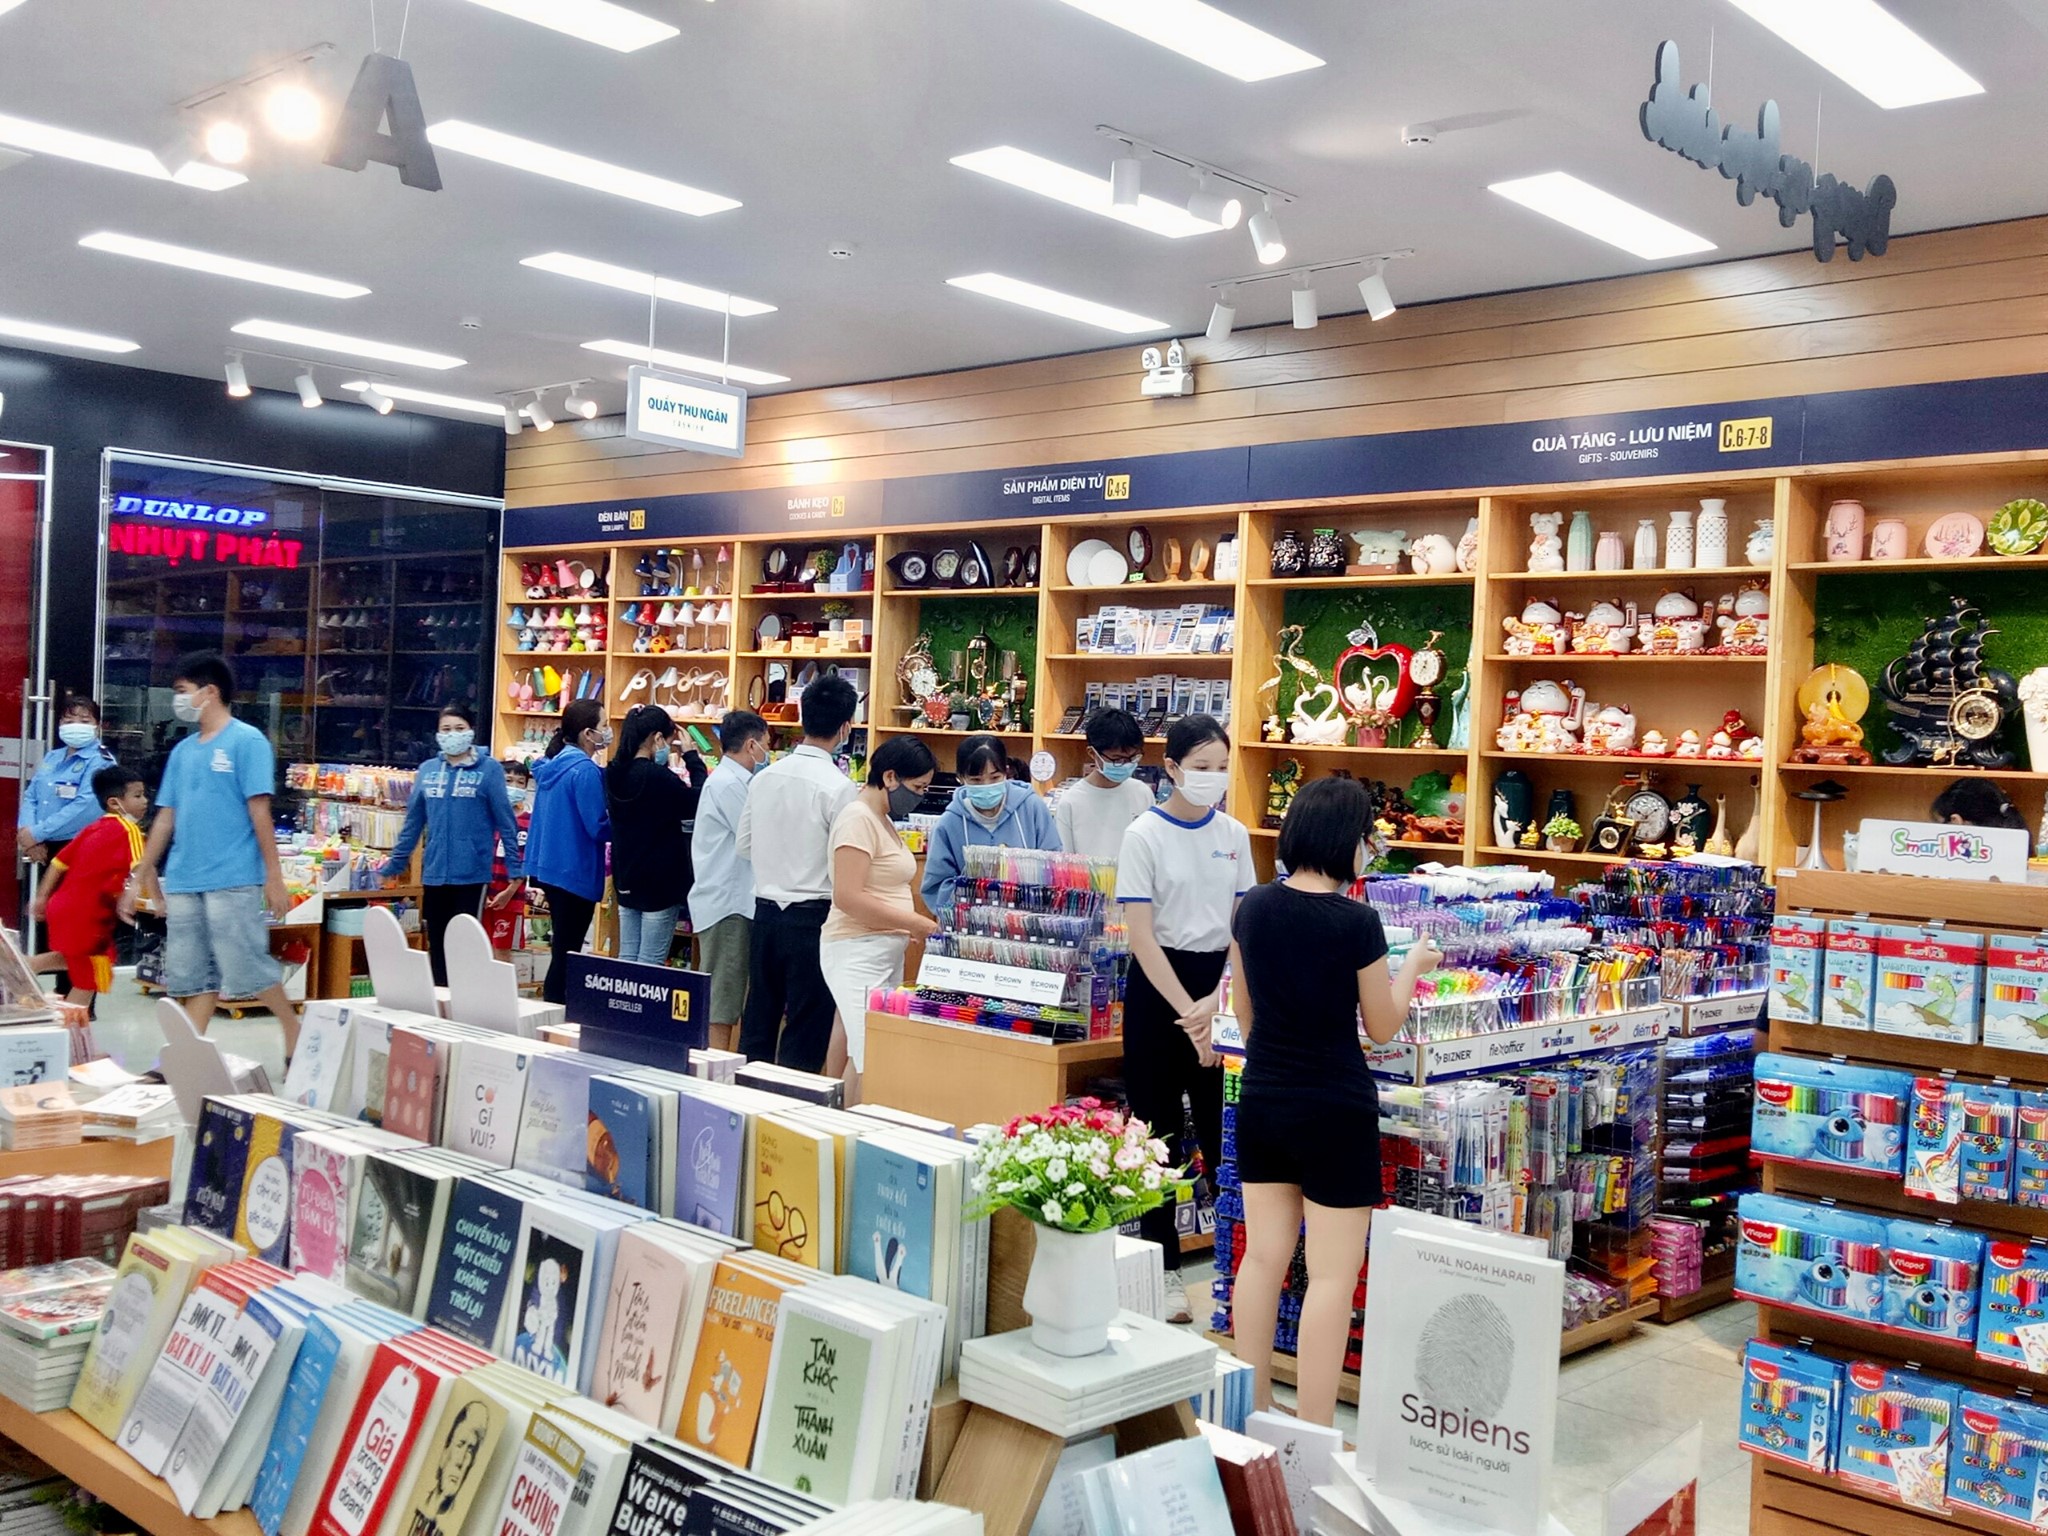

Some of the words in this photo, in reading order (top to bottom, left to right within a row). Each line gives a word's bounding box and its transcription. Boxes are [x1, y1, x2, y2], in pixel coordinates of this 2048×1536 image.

[677, 403, 698, 418] THU
[699, 407, 728, 424] NGÂN
[1532, 434, 1567, 452] QUÀ
[1570, 429, 1616, 452] TẶNG
[1629, 426, 1663, 445] LƯU
[1667, 421, 1712, 442] NIỆM
[1722, 423, 1768, 448] C.6-7-8
[1578, 452, 1602, 464] GIFTS
[1610, 448, 1659, 462] SOUVENIRS
[1003, 479, 1025, 495] SẢN
[1027, 475, 1059, 493] PHẨM
[1060, 476, 1086, 492] ĐIỆN
[1107, 478, 1127, 498] C.4-5
[1032, 494, 1053, 504] DIGITAL
[1053, 493, 1071, 502] ITEMS
[114, 495, 268, 527] DUNLOP
[788, 497, 811, 510] BÁNH
[109, 522, 210, 567] NHỤT
[215, 529, 303, 570] PHÁT
[585, 973, 614, 992] SÁCH
[614, 978, 638, 997] BÁN
[639, 983, 670, 1003] CHẠY
[673, 992, 688, 1018] A.3
[608, 998, 643, 1013] BESTSELLER
[1443, 1049, 1472, 1064] BIZNER
[470, 1128, 496, 1150] VUI?
[453, 1266, 490, 1296] KHÔNG
[1416, 1249, 1452, 1267] YUVAL
[1455, 1257, 1489, 1275] NOAH
[1491, 1265, 1536, 1285] HARARI
[708, 1286, 778, 1328] FREELANCER
[810, 1337, 837, 1366] TÀN
[803, 1360, 839, 1394] KHỐC
[794, 1404, 835, 1437] THANH
[1400, 1393, 1531, 1455] Sapiens
[365, 1418, 397, 1466] Giá
[792, 1434, 828, 1461] XUÂN
[1409, 1435, 1434, 1454] lược
[1452, 1447, 1474, 1463] loài
[1476, 1453, 1511, 1474] người
[356, 1445, 384, 1486] trong
[354, 1473, 373, 1504] kinh
[338, 1486, 366, 1523] doanh
